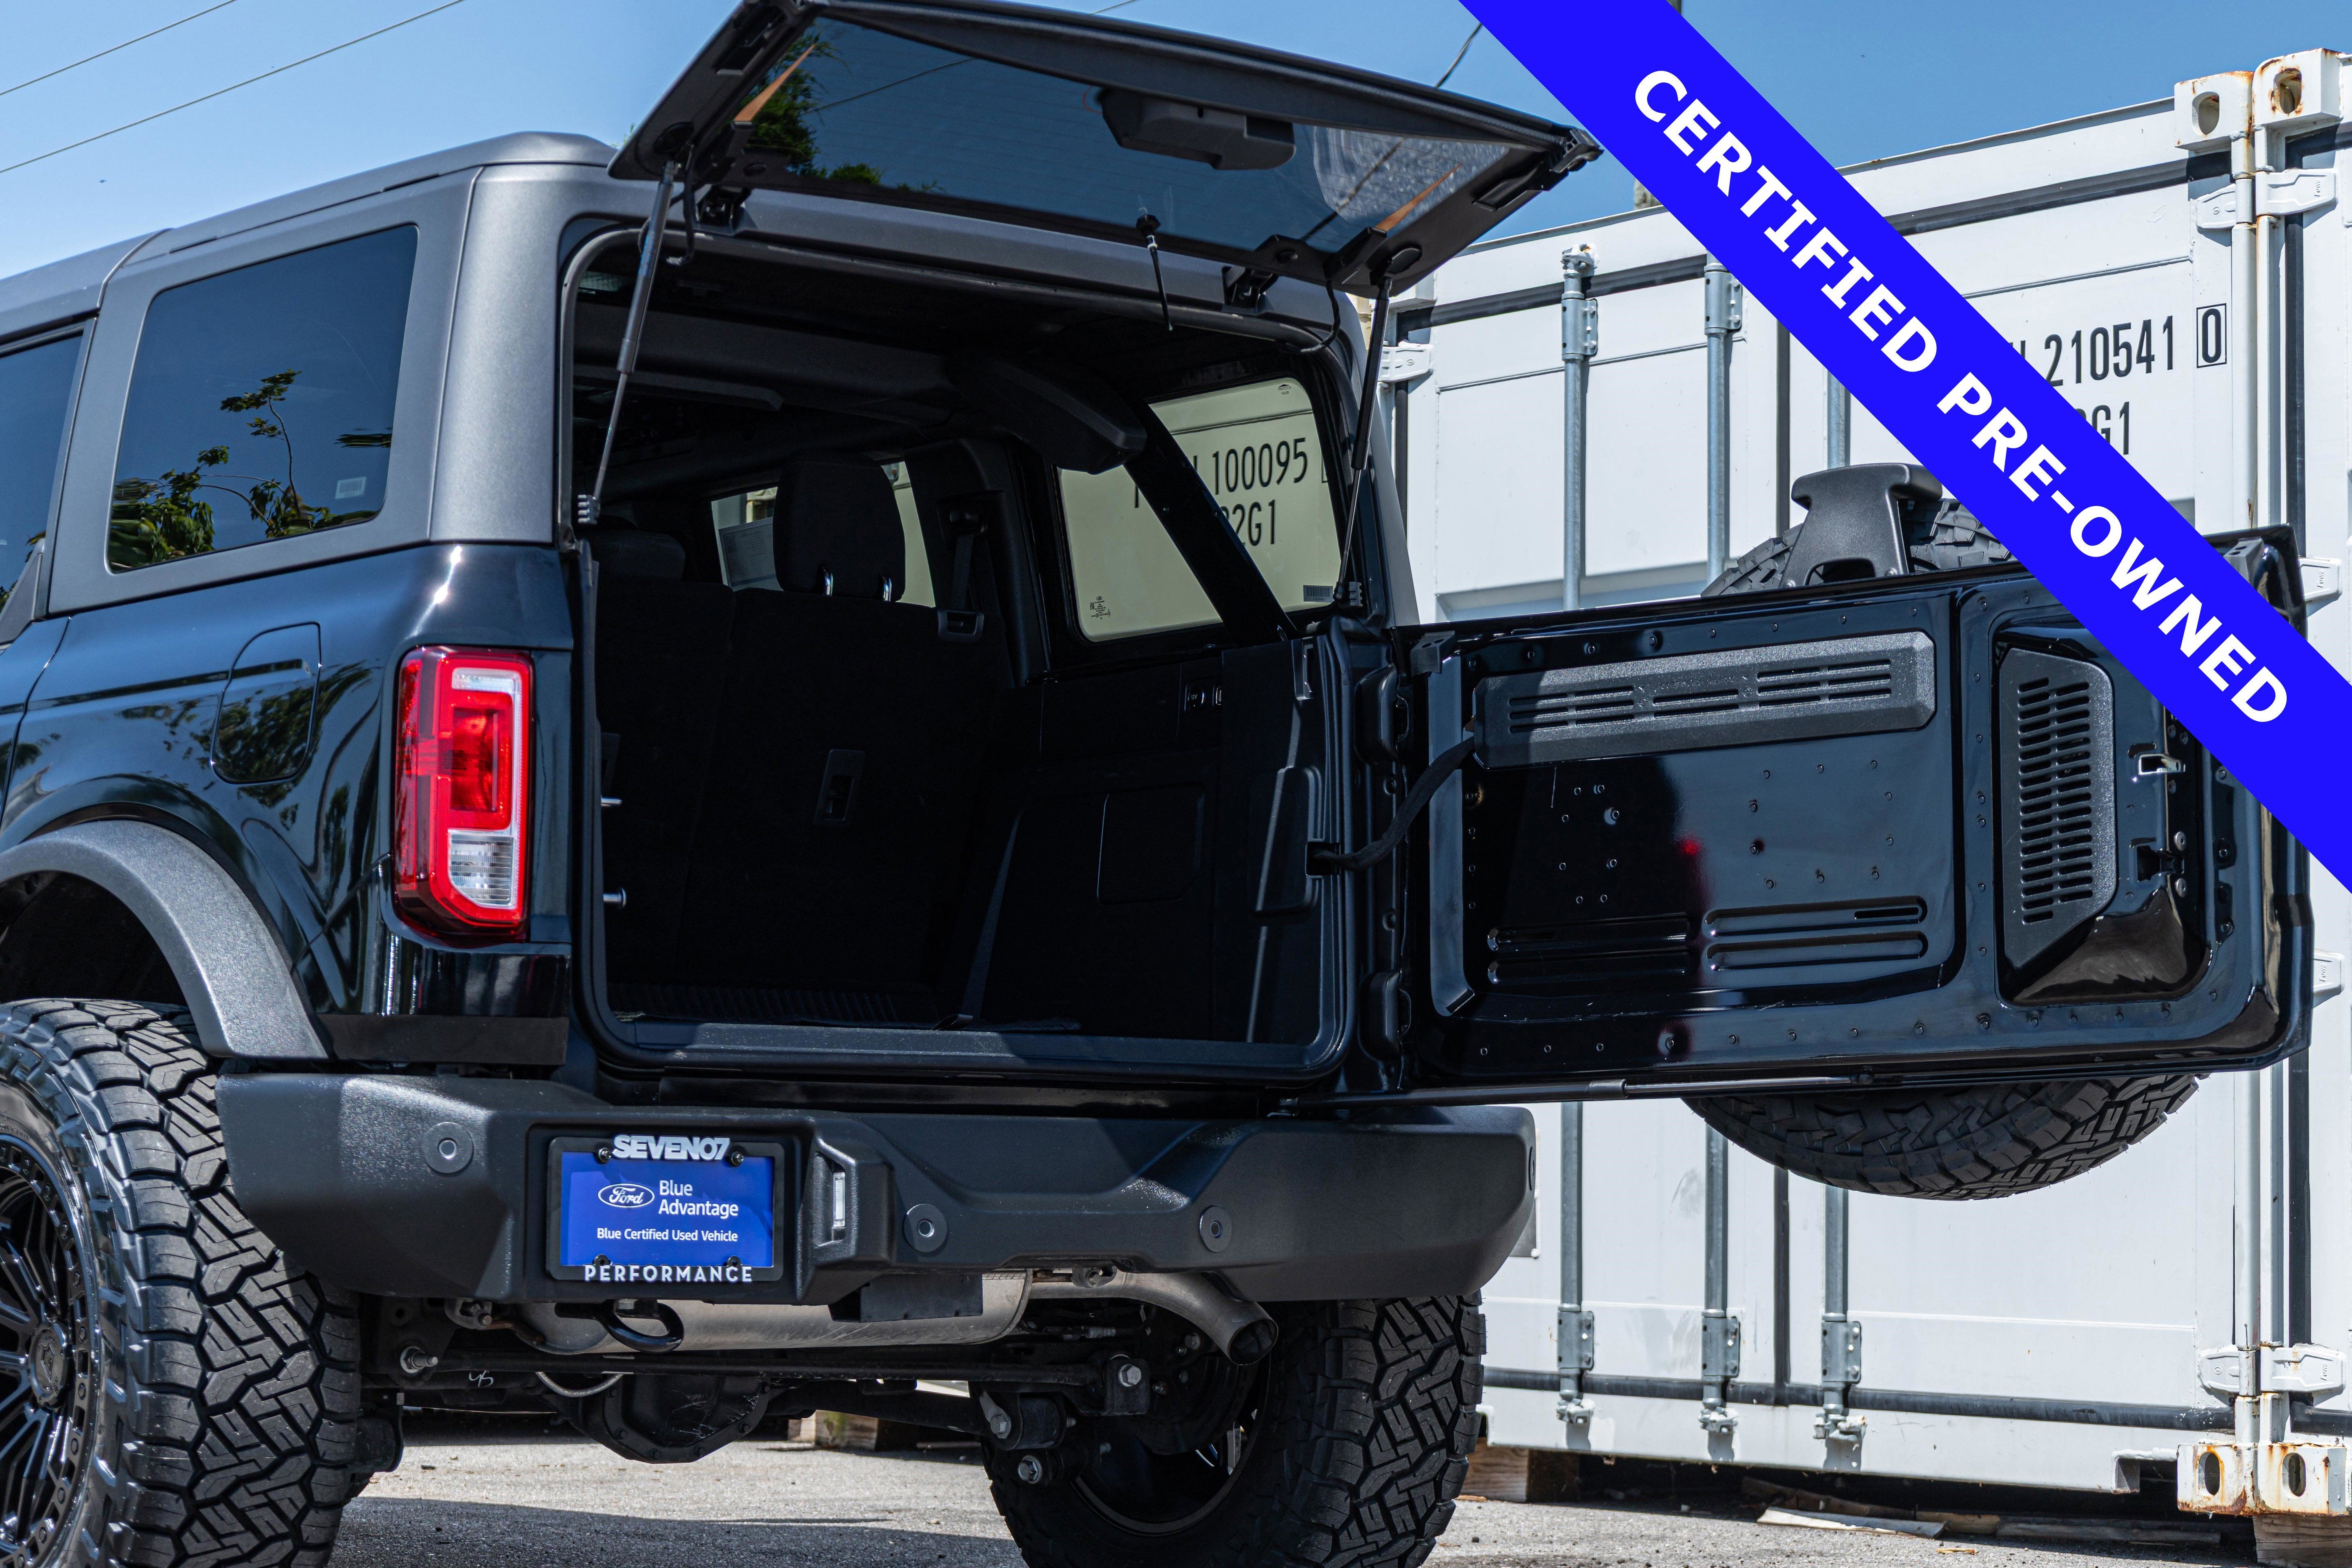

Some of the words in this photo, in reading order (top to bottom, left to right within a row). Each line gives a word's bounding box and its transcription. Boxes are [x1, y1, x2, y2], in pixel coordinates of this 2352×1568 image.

[2045, 316, 2173, 387] 210541
[2202, 308, 2221, 363] 0
[2076, 401, 2129, 455] G1
[1212, 437, 1307, 495] 100095
[609, 1187, 644, 1204] Ford
[659, 1180, 693, 1196] Blue
[658, 1198, 739, 1219] Advantage
[597, 1227, 621, 1239] Blue
[624, 1228, 669, 1240] Certified
[672, 1229, 698, 1241] Used
[701, 1230, 738, 1242] Vehicle
[584, 1265, 752, 1282] PERFORMANCE
